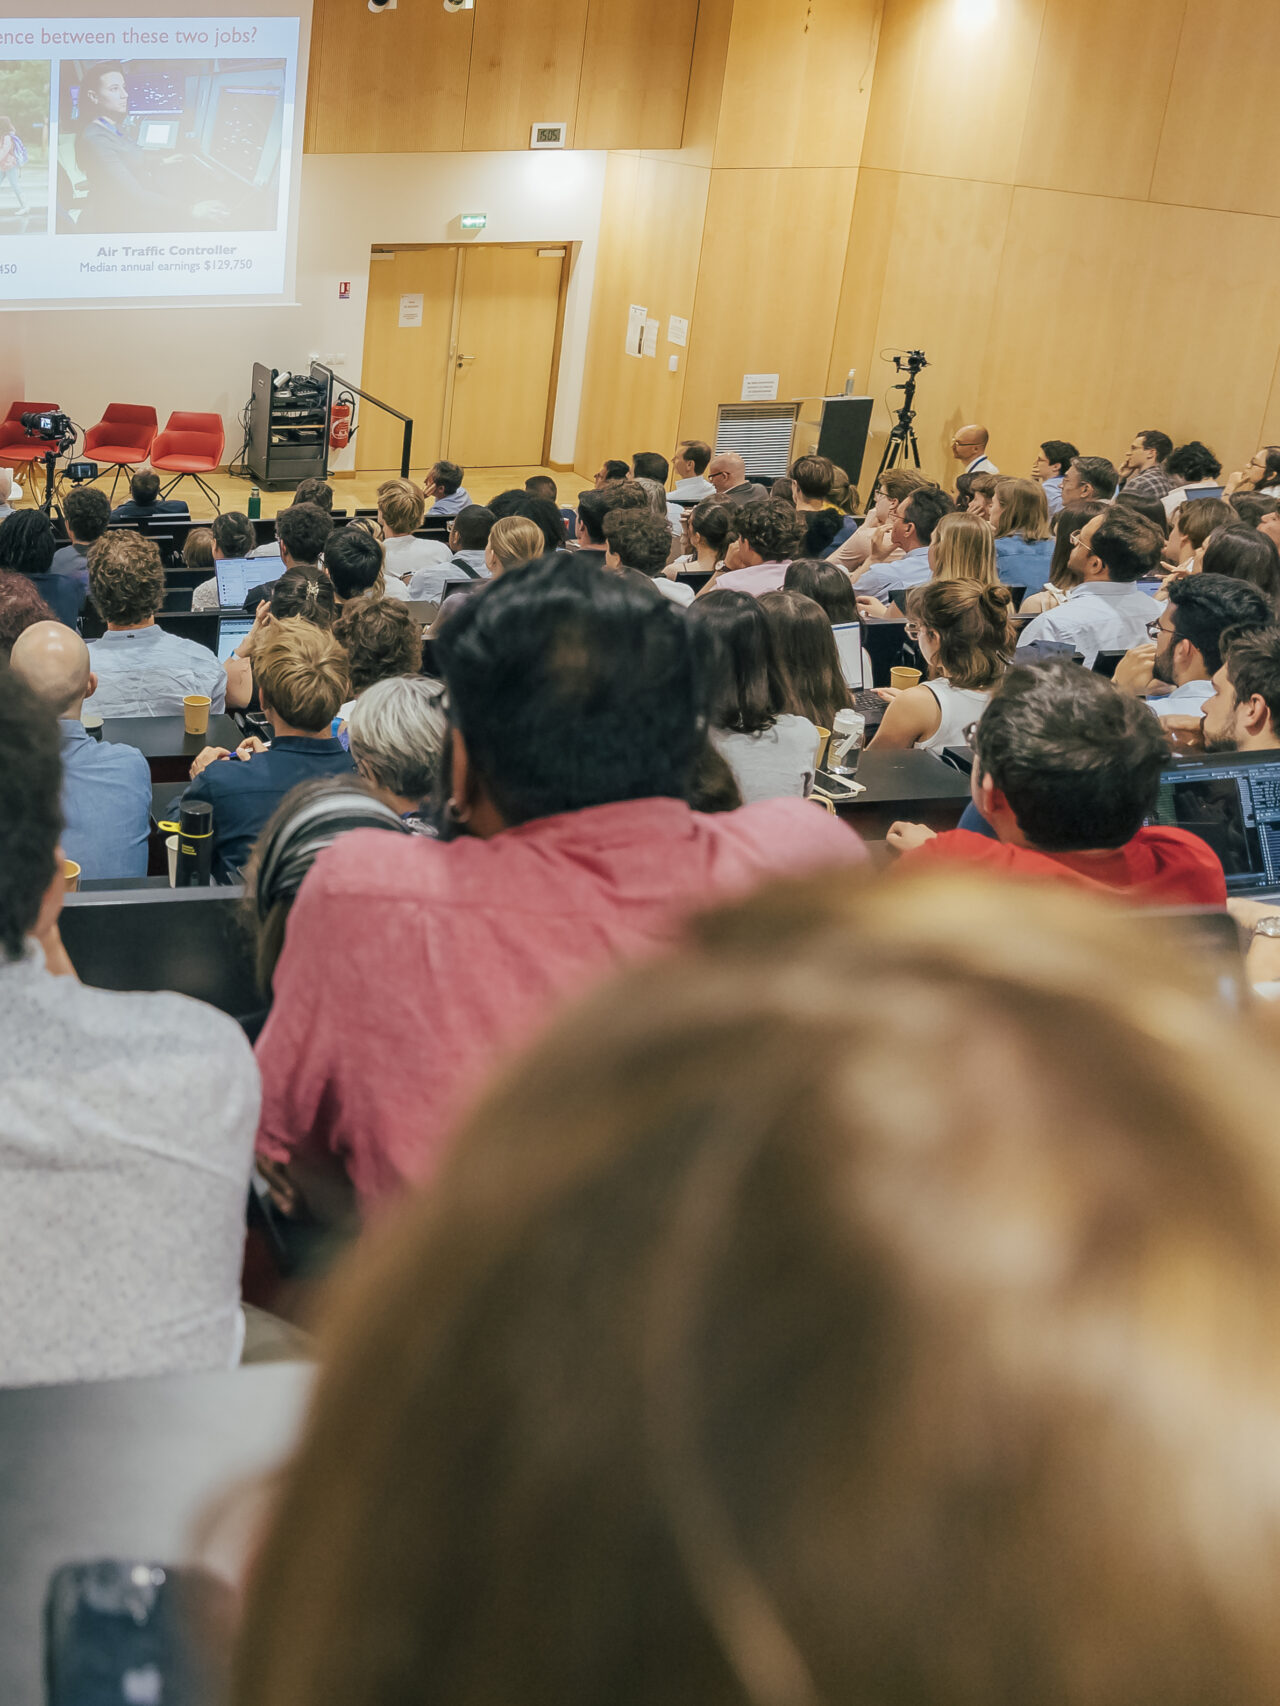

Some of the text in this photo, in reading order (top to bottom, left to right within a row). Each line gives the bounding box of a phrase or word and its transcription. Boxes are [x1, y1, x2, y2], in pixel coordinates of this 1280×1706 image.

[41, 27, 116, 45] between
[122, 27, 169, 44] these
[175, 29, 209, 44] two
[214, 26, 258, 48] jobs?
[96, 245, 237, 257] Air Traffic Controller
[80, 259, 253, 273] Median annual earnings $129,750
